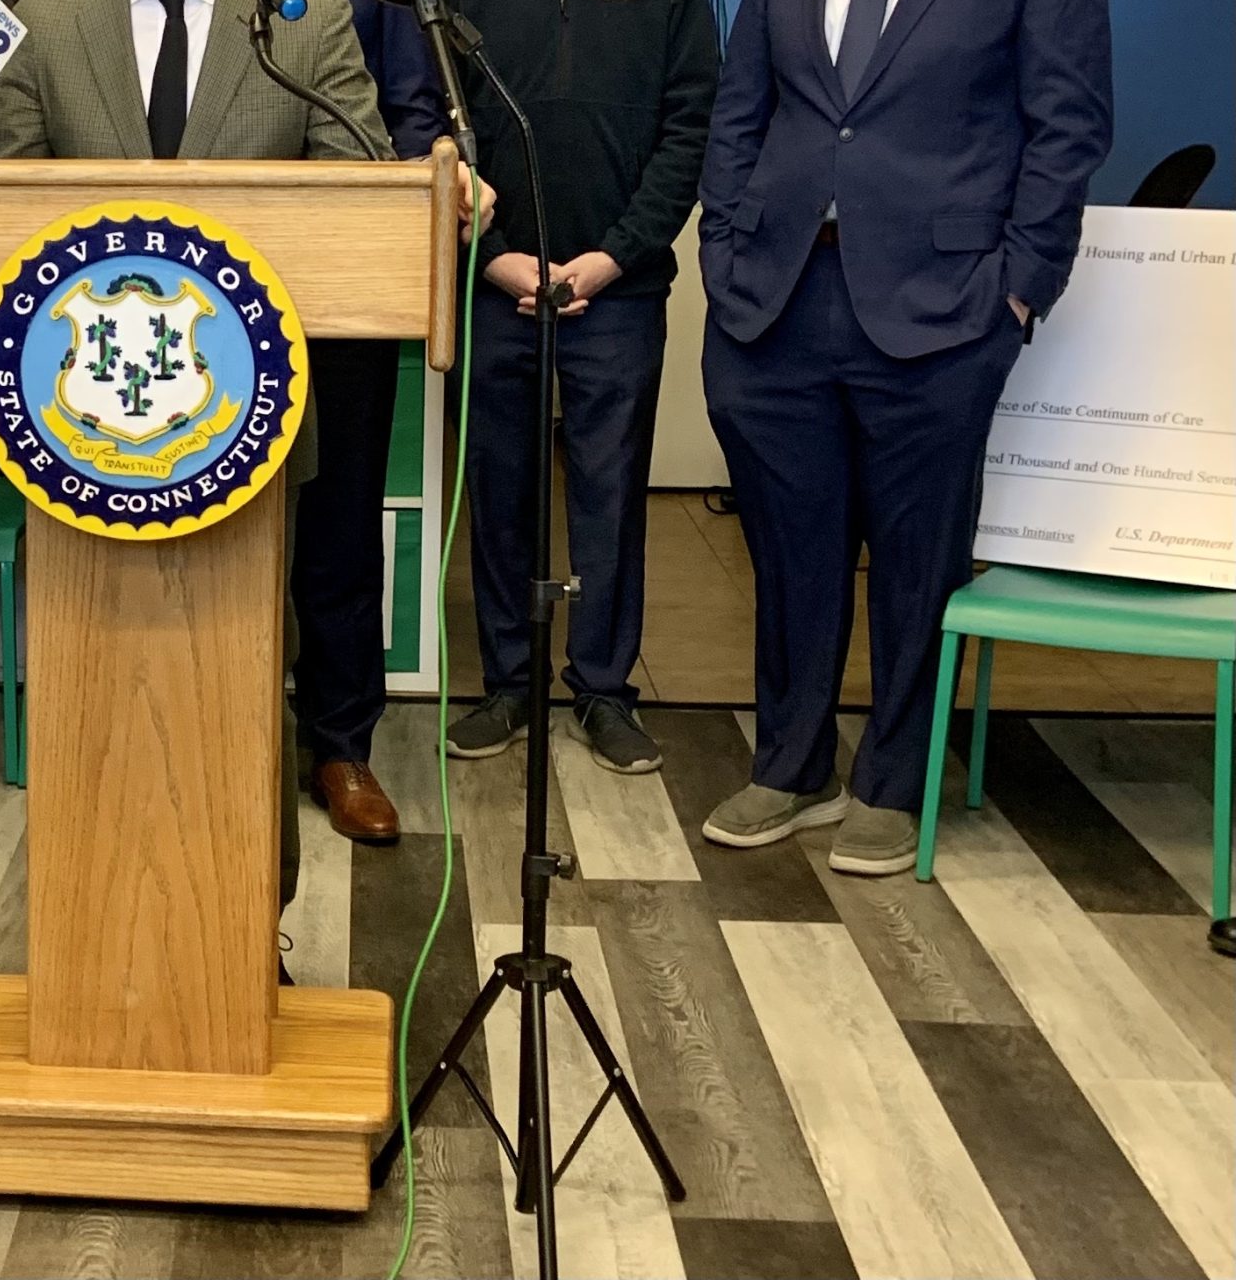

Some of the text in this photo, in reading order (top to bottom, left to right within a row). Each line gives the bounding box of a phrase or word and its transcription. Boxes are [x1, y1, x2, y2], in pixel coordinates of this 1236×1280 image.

[1084, 245, 1145, 264] Housing
[1149, 249, 1176, 262] and
[1181, 249, 1226, 265] Urban
[12, 231, 264, 325] GOVERNOR
[1022, 401, 1038, 412] of
[1040, 402, 1071, 416] State
[1076, 404, 1149, 423] Continuum
[1153, 411, 1169, 423] of
[1171, 411, 1204, 427] Care
[61, 474, 100, 503] OF
[107, 372, 279, 513] CONNECTICUT
[1009, 453, 1071, 471] Thousand
[1074, 460, 1098, 473] and
[1102, 462, 1130, 476] One
[1134, 464, 1192, 482] Hundred
[1022, 525, 1075, 542] Initiative
[1115, 527, 1143, 541] U.S.
[1148, 530, 1234, 551] Department
